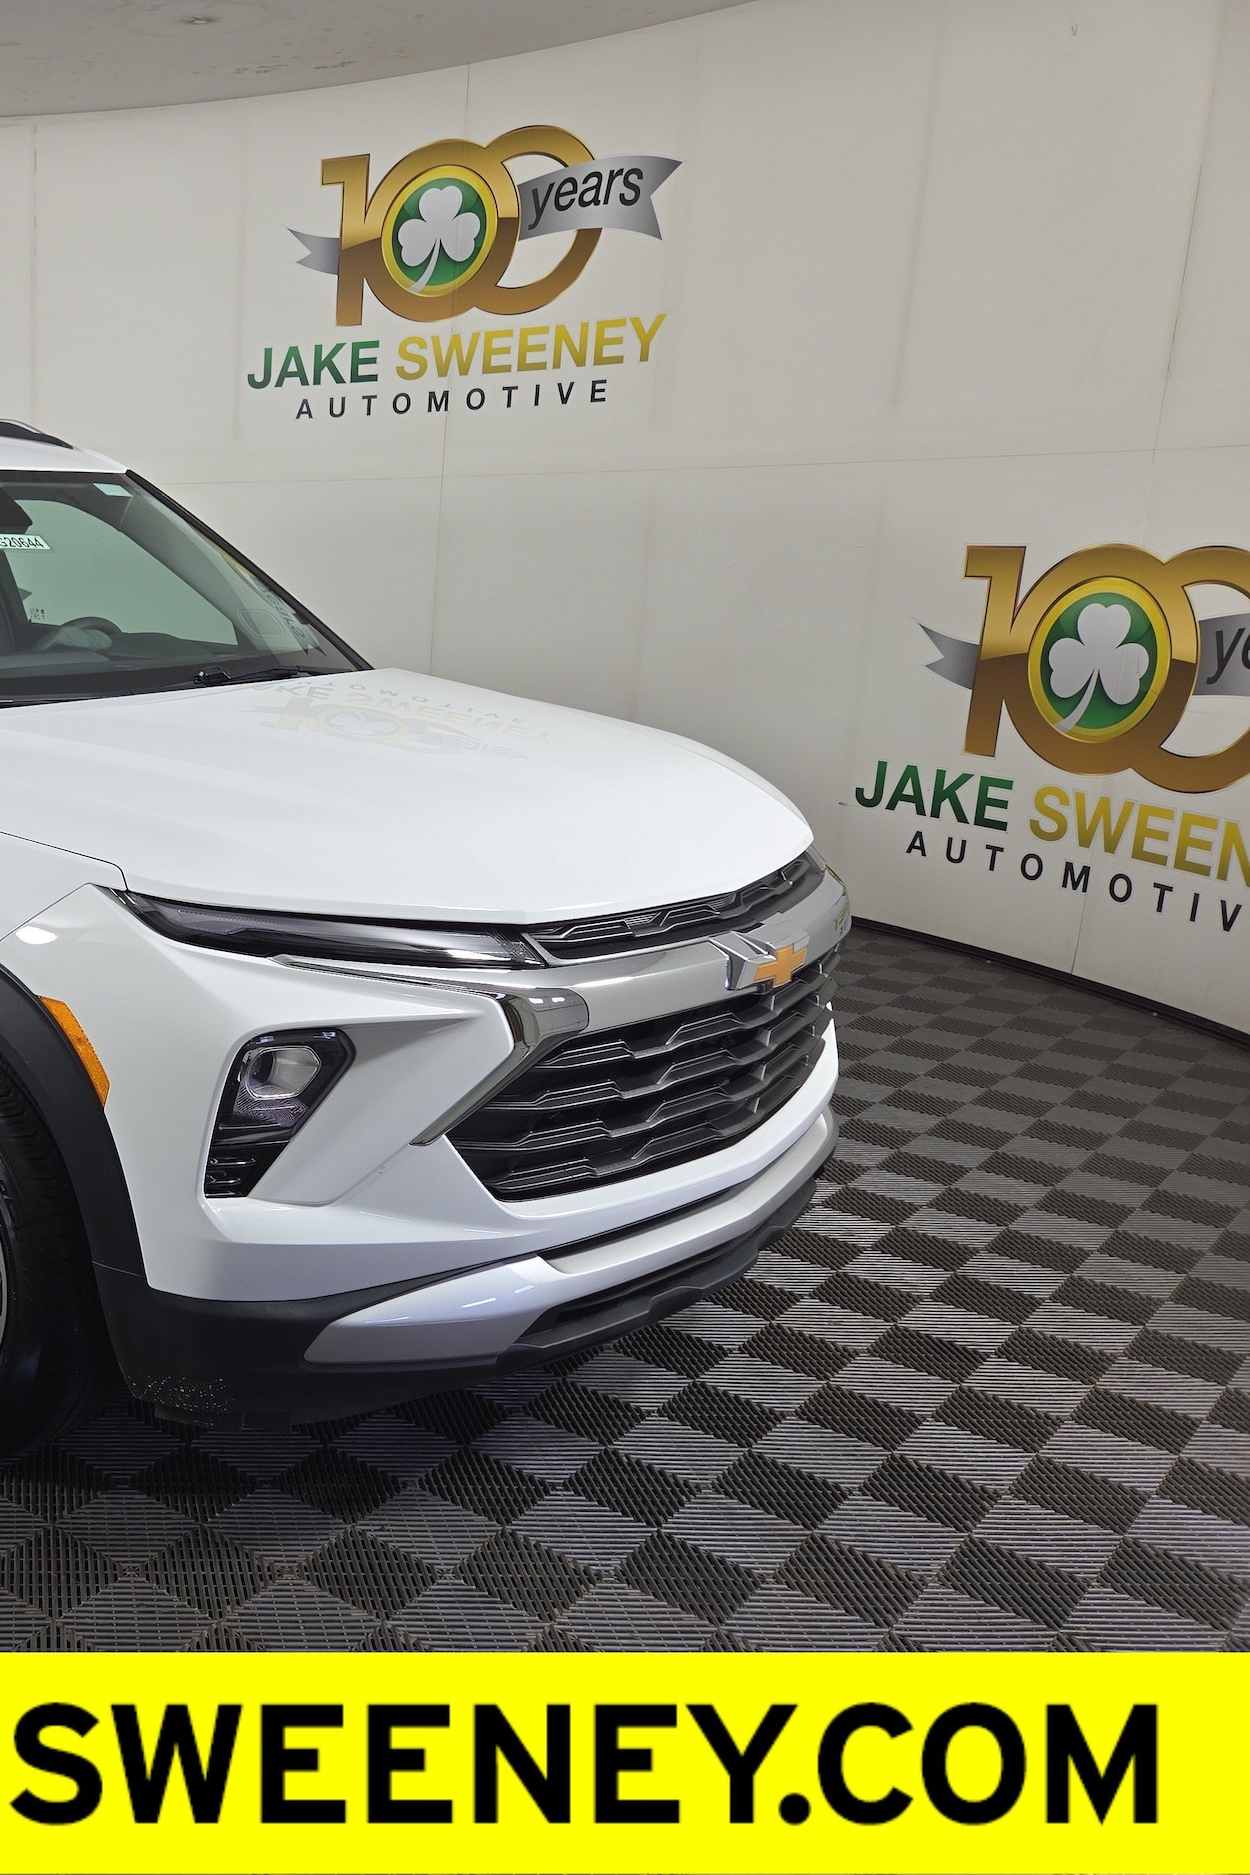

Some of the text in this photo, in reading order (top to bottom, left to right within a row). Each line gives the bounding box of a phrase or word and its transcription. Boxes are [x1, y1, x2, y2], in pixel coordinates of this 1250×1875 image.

[320, 124, 644, 327] 100 years
[247, 312, 668, 391] JAKE SWEENEY
[295, 379, 608, 420] AUTOMOTIVE
[1205, 627, 1250, 685] y
[855, 760, 1015, 832] JAKE
[905, 830, 1243, 933] AUTOMOTIV
